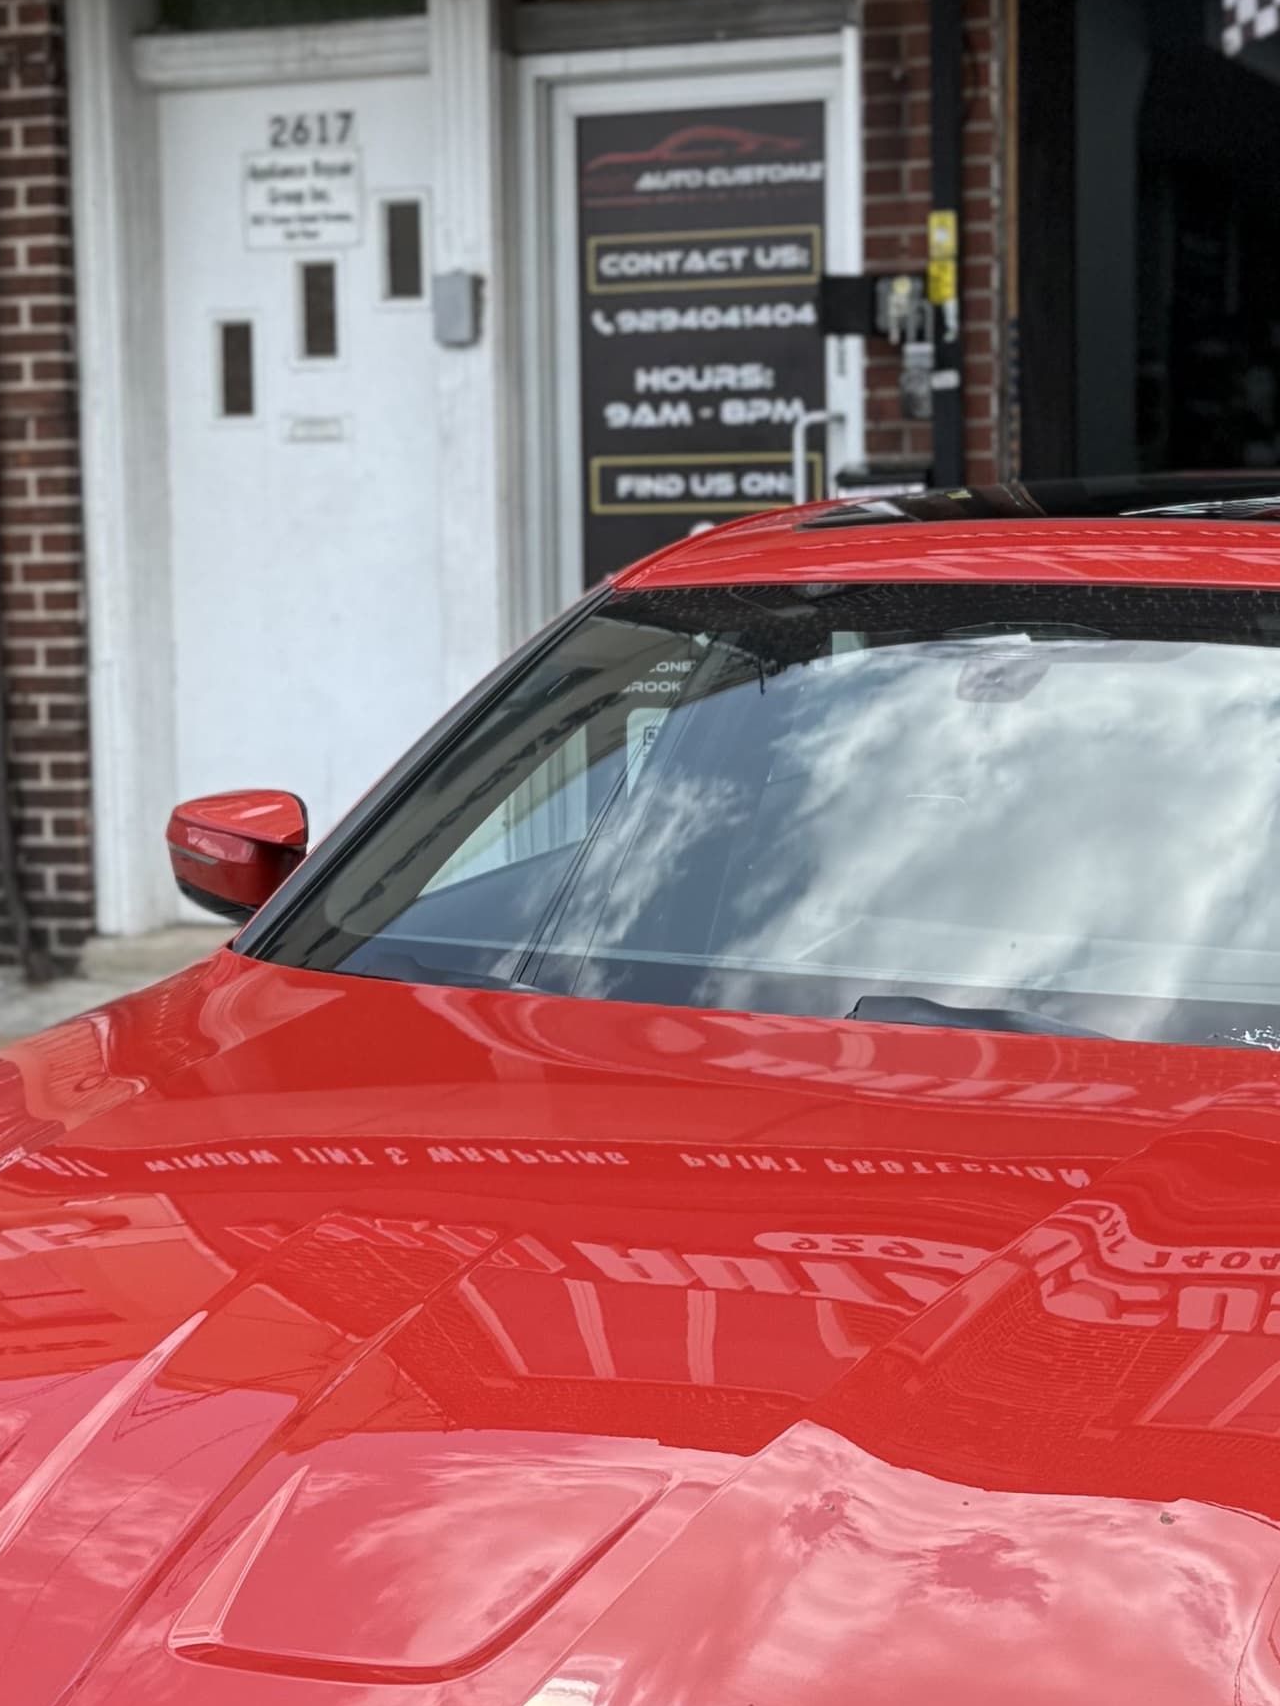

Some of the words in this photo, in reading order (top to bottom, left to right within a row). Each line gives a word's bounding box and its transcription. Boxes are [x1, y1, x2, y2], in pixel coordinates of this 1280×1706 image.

[269, 111, 355, 149] 2617
[634, 167, 704, 192] AUTO
[598, 247, 750, 277] CONTACT
[755, 243, 811, 270] US:
[615, 302, 818, 334] 9294041404
[634, 363, 775, 393] HOURS:
[603, 401, 694, 429] 9AM
[615, 473, 686, 499] FIND
[689, 472, 737, 498] US
